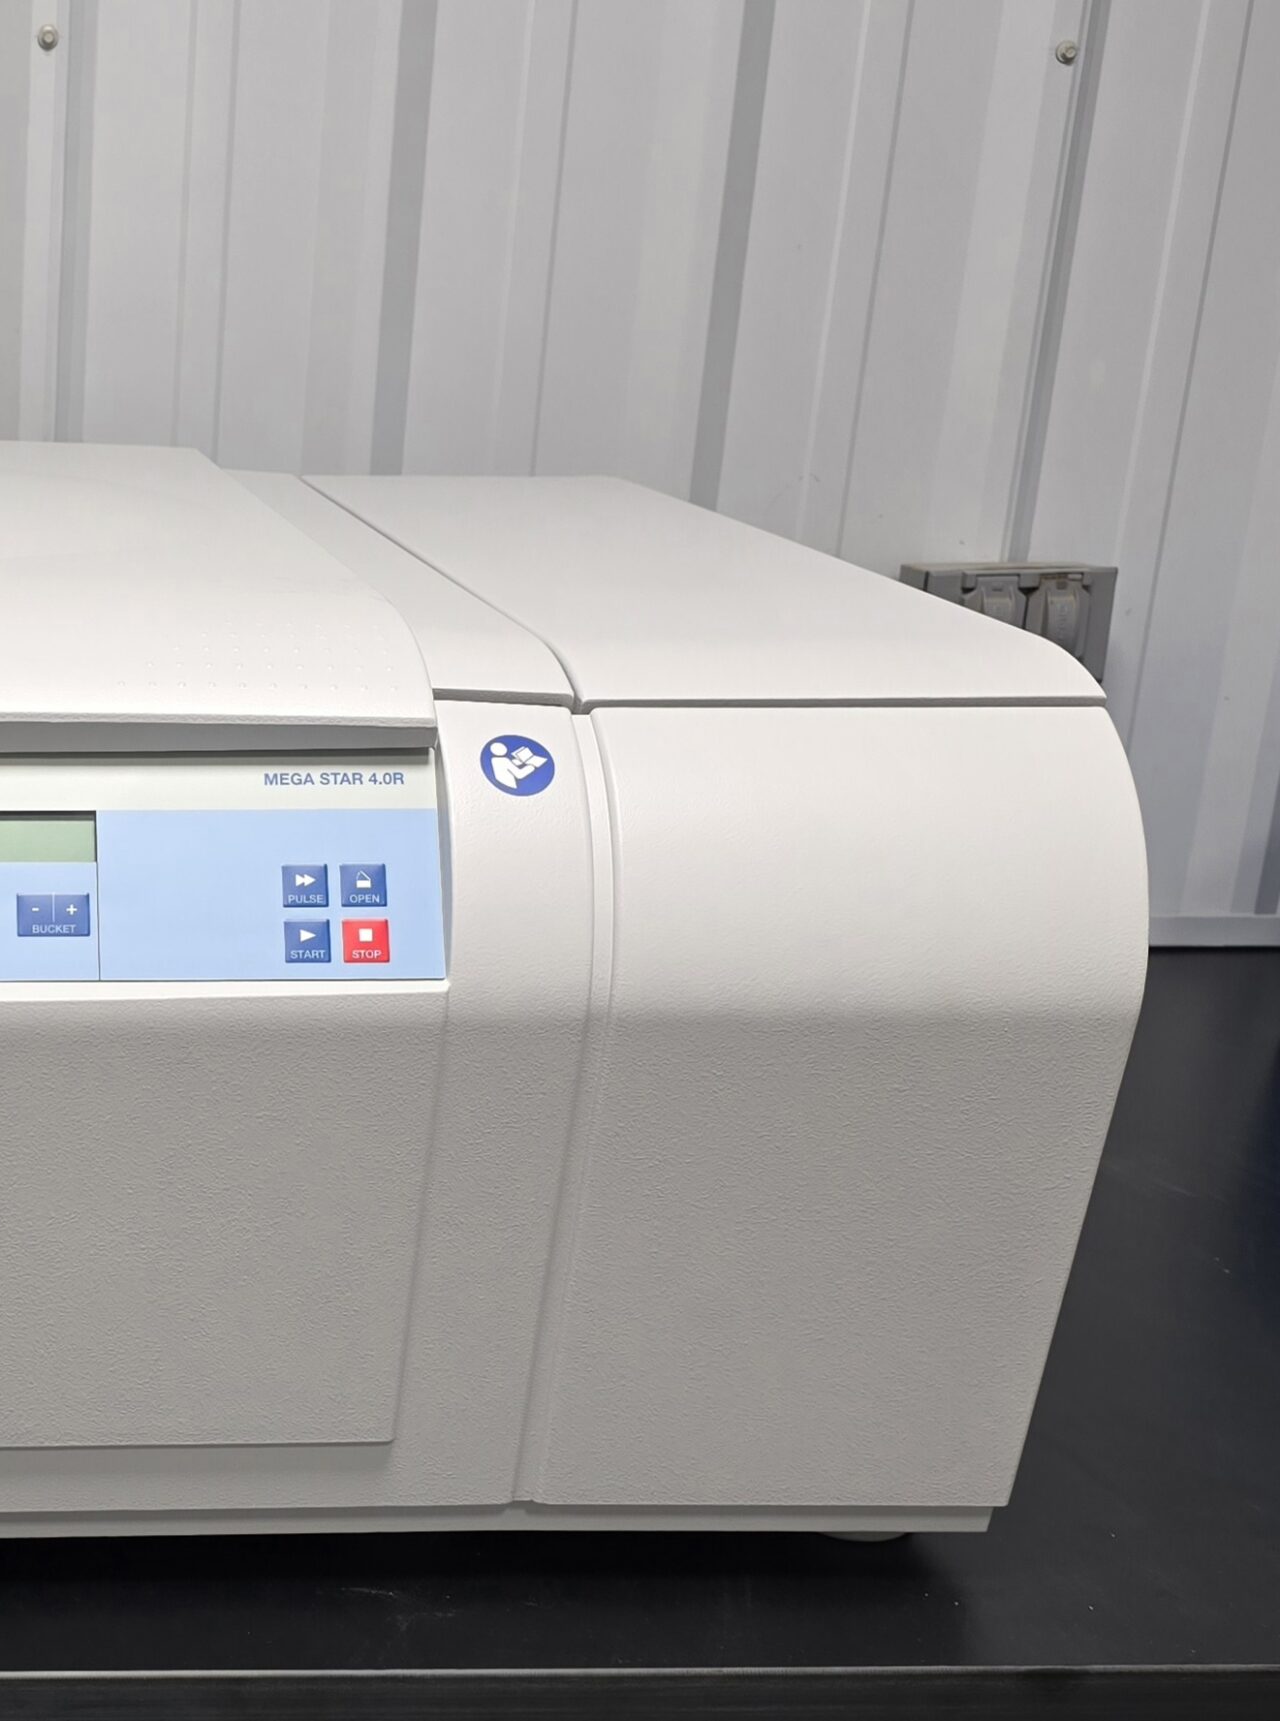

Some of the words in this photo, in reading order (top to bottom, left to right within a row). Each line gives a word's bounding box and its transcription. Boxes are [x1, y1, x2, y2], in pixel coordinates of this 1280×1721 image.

[264, 773, 315, 786] MEGA
[319, 772, 364, 785] STAR
[368, 772, 405, 785] 4.0R
[287, 894, 324, 904] PULSE
[349, 894, 380, 904] OPEN
[32, 924, 76, 934] BUCKET
[290, 949, 326, 959] START
[351, 949, 382, 959] STOP
